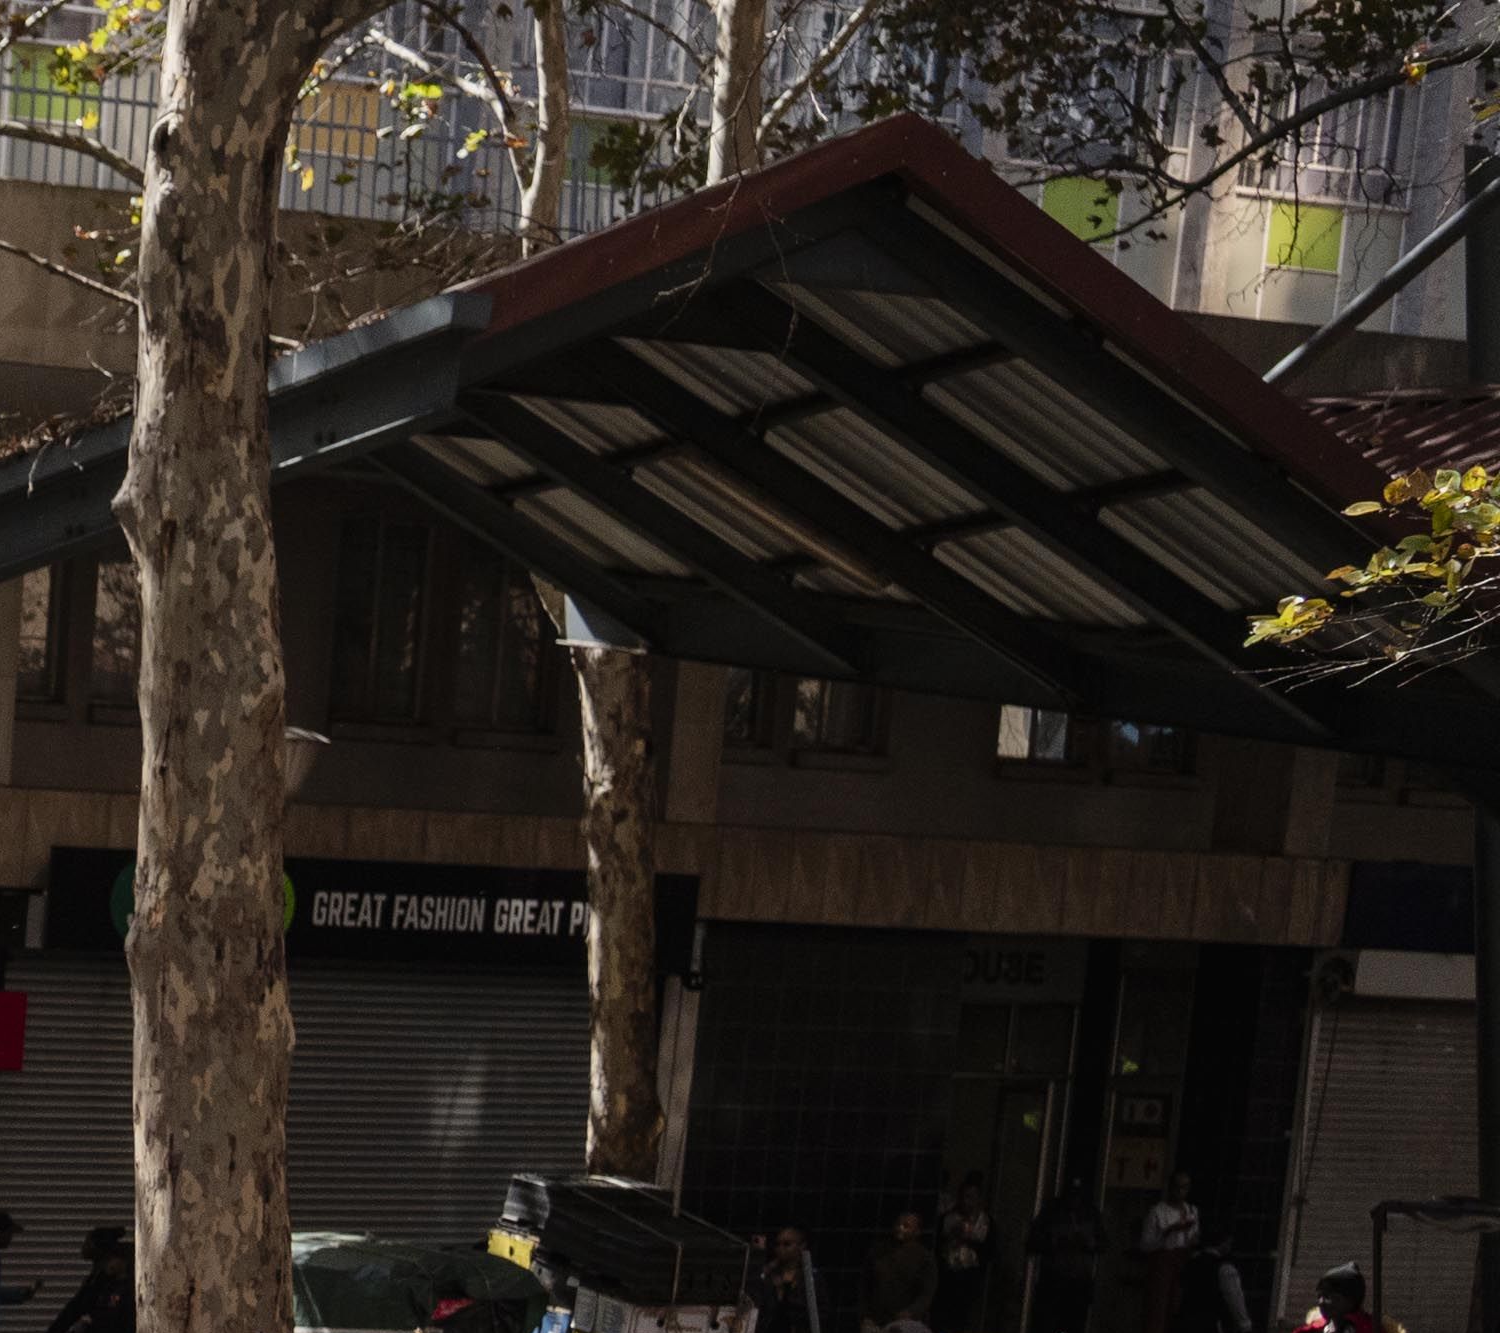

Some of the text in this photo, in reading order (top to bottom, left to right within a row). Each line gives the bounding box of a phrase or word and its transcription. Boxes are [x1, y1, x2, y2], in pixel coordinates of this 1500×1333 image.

[312, 890, 384, 927] GREAT
[391, 895, 485, 933] FASHION
[493, 897, 563, 935] GREAT
